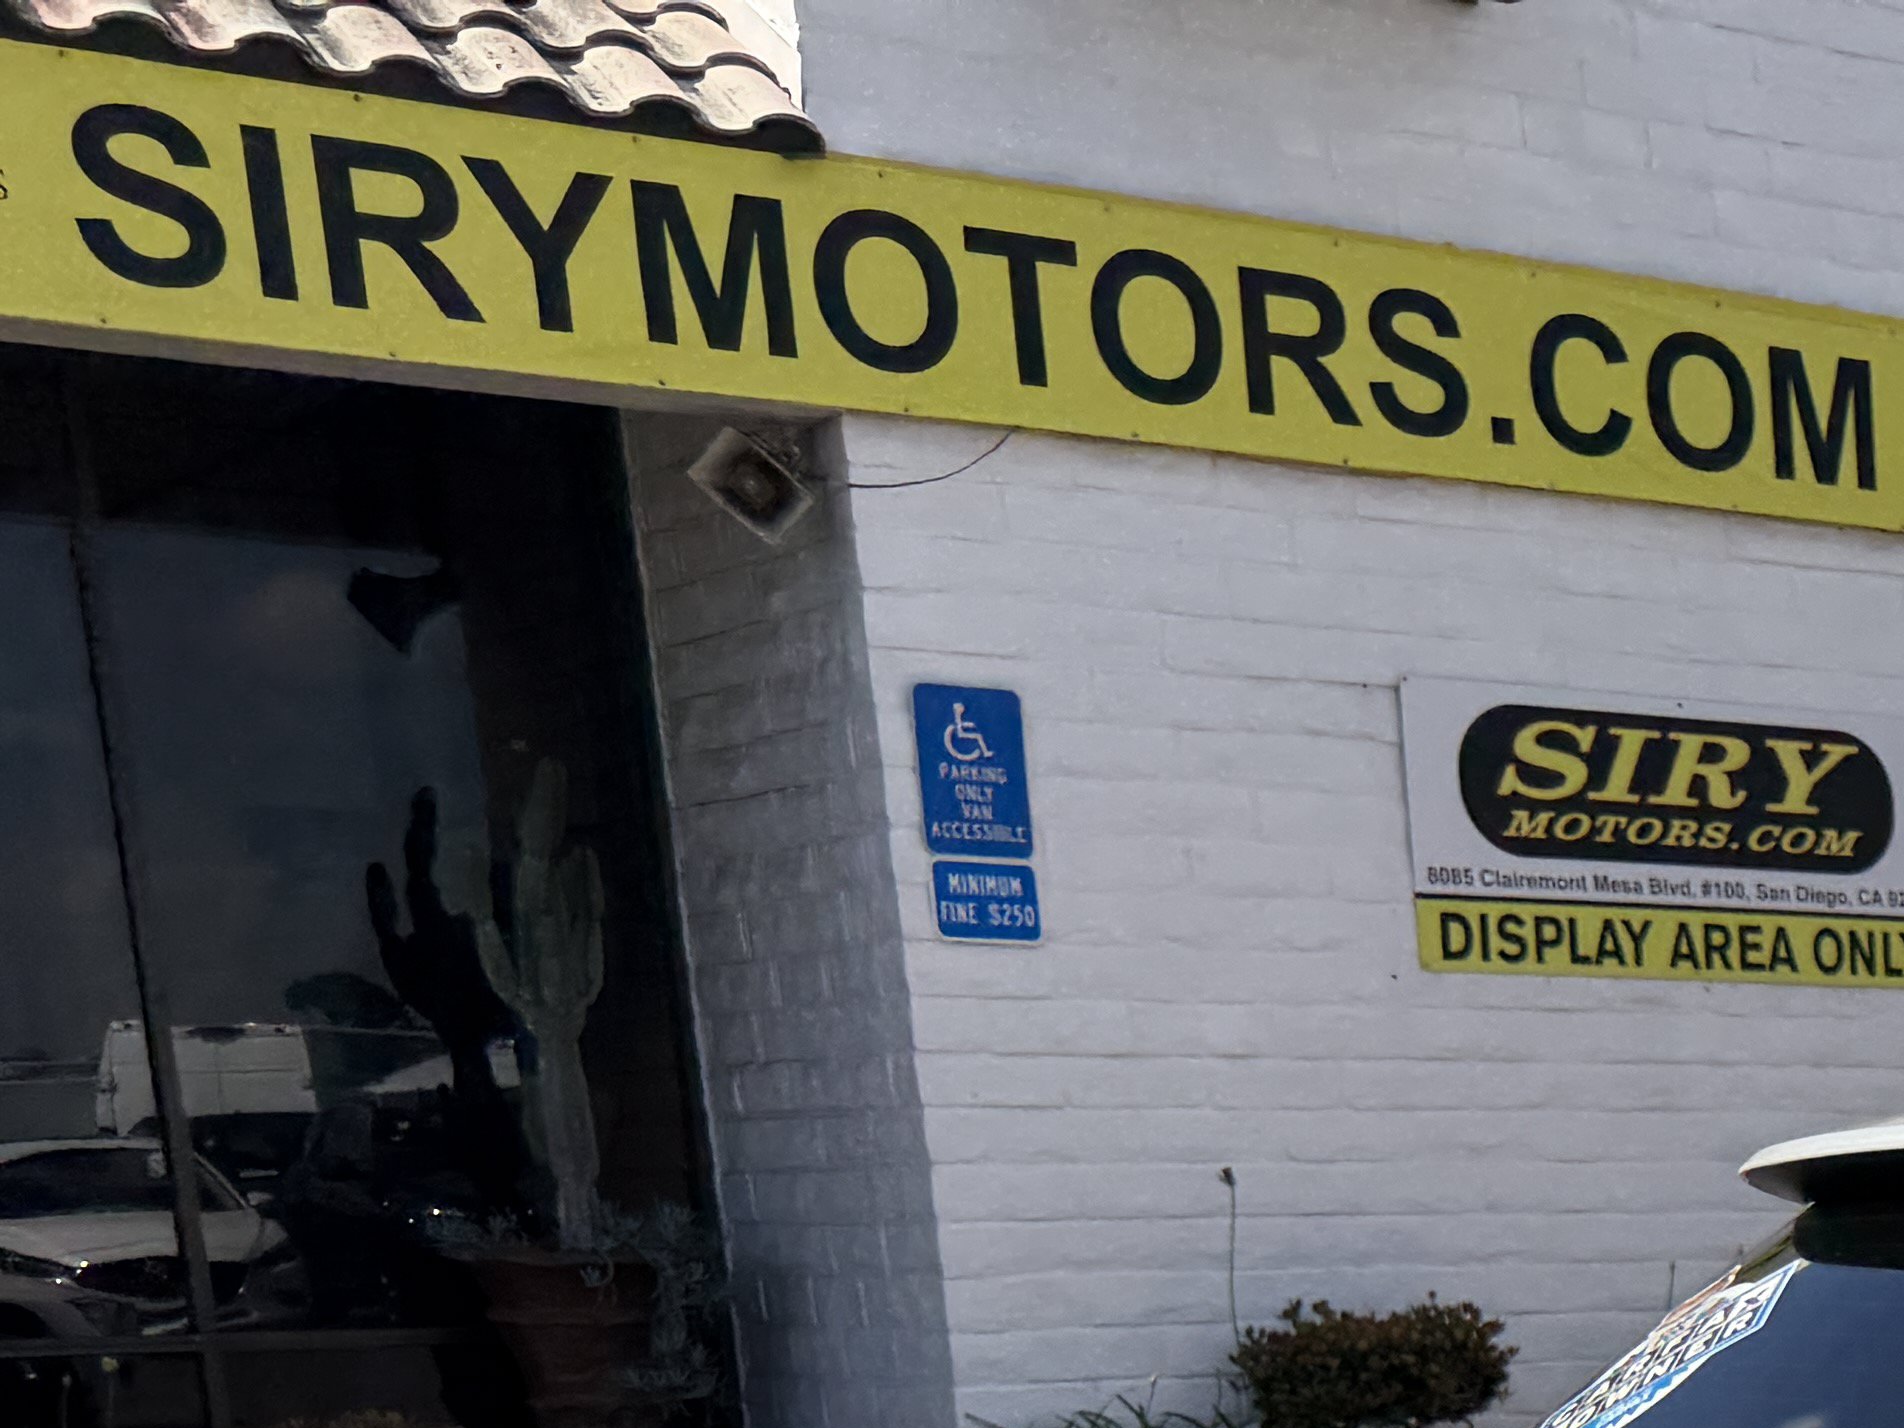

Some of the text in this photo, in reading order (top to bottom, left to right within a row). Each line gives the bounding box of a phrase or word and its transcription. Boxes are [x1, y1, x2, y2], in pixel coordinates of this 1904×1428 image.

[71, 103, 1878, 492] SIRYMOTORS.COM
[1496, 720, 1860, 816] SIRY
[955, 785, 993, 802] ONLY
[961, 803, 993, 821] VAN
[1502, 809, 1863, 858] MOTORS.COM
[947, 873, 1025, 897] MINIMUM
[1479, 869, 1588, 893] Clairemont
[1592, 874, 1644, 895] Mesa
[1756, 883, 1791, 903] San
[1858, 889, 1884, 905] CA
[940, 901, 1036, 927] FINE $250
[1440, 912, 1653, 969] DISPLAY
[1669, 921, 1800, 974] AREA
